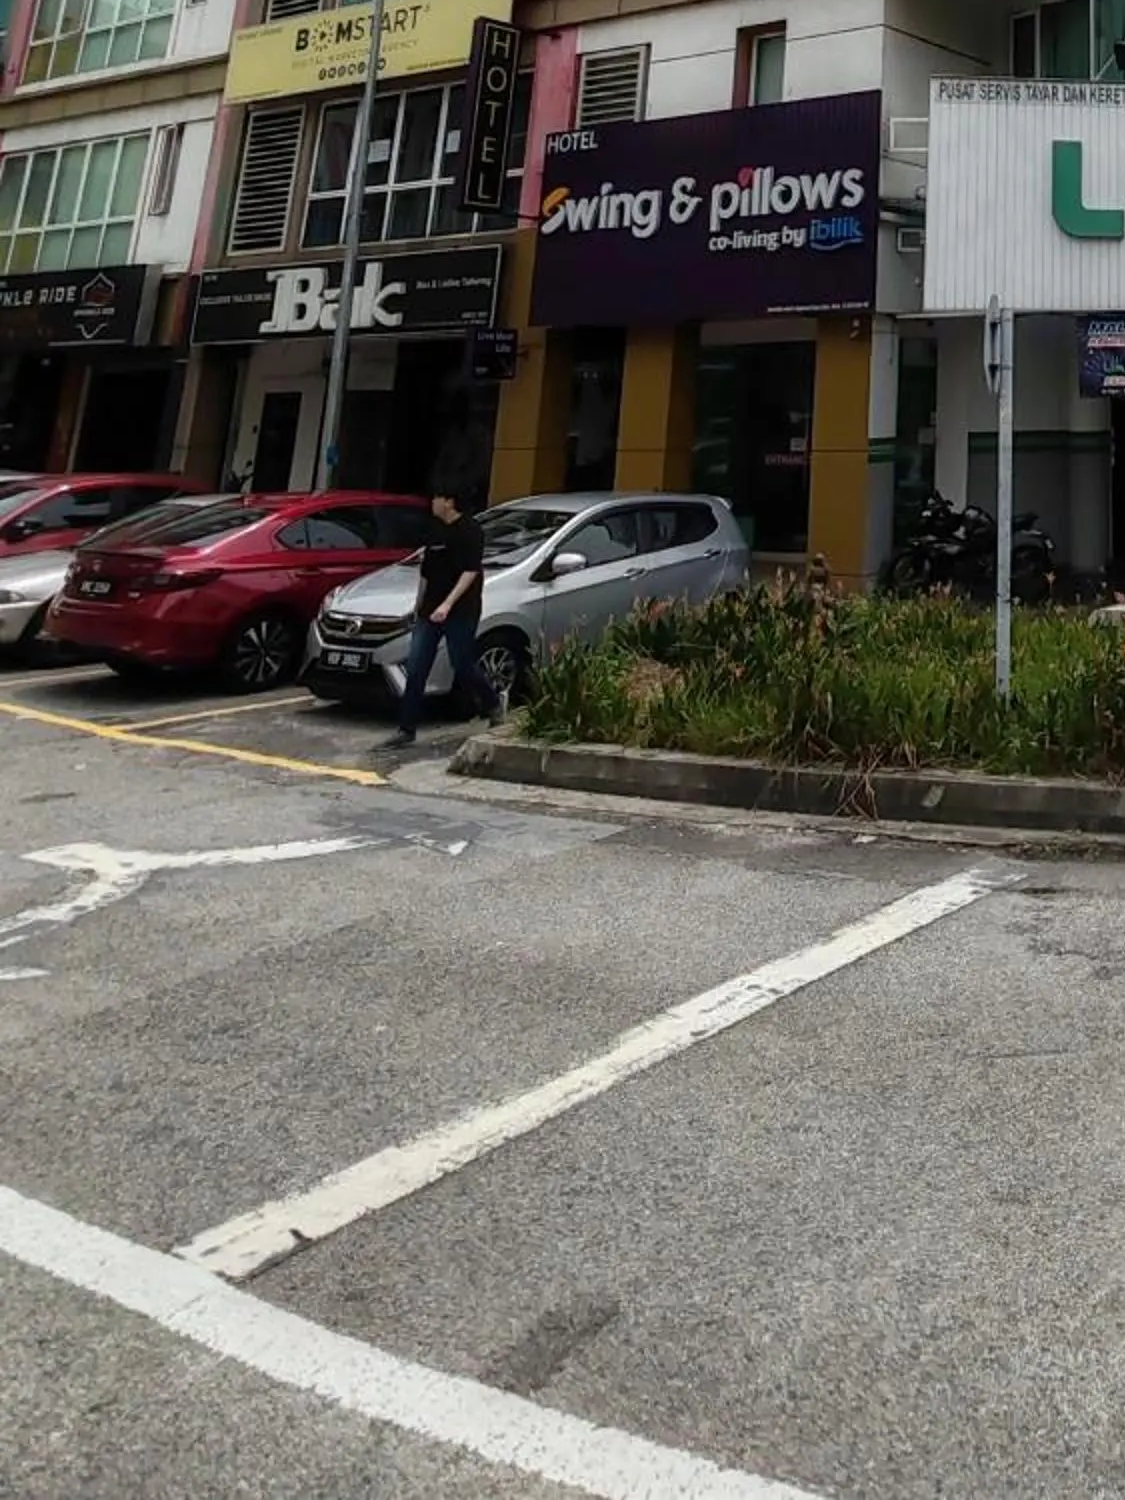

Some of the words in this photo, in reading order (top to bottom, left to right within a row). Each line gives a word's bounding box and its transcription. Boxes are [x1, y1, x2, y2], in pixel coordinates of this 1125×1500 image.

[939, 82, 975, 100] PUSAT
[979, 83, 1021, 101] SERVIS
[1025, 84, 1059, 102] TAYAR
[1063, 85, 1087, 103] DAN
[477, 30, 511, 200] HOTEL
[546, 130, 599, 154] HOTEL
[541, 181, 663, 239] Swing
[668, 176, 704, 225] &
[709, 165, 866, 232] pillows
[709, 230, 779, 252] co-living
[782, 225, 806, 248] by
[809, 216, 865, 247] ibilik
